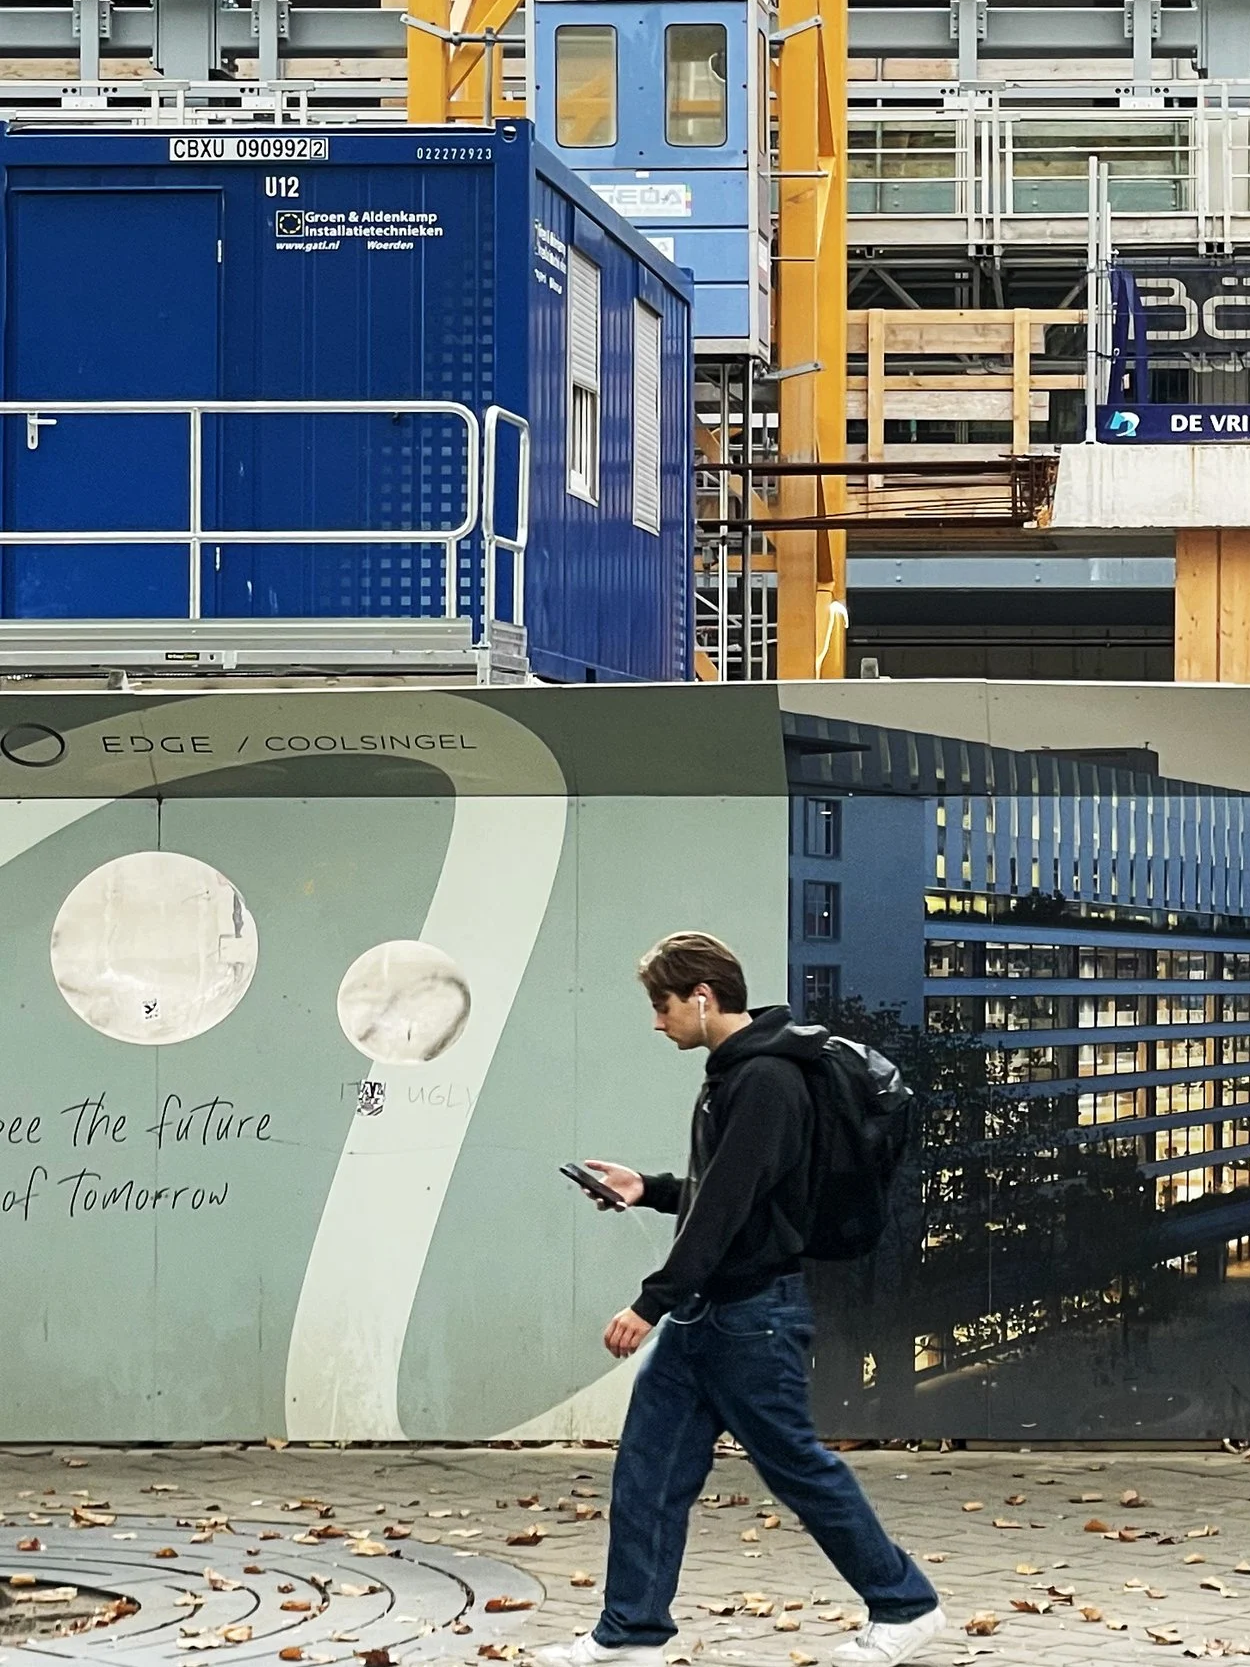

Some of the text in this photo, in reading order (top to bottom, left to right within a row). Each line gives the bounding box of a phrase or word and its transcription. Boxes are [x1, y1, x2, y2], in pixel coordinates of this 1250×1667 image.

[174, 139, 225, 157] CBXU
[416, 148, 492, 160] 022272923
[265, 176, 299, 197] U12
[305, 211, 438, 225] Groen & Aldenkamp
[305, 224, 443, 237] Installatietechnieken
[366, 240, 414, 251] Woerden
[1171, 414, 1202, 433] DE
[102, 736, 214, 753] EDGE
[265, 734, 478, 753] COOLSINGEL
[2, 1166, 48, 1221] of
